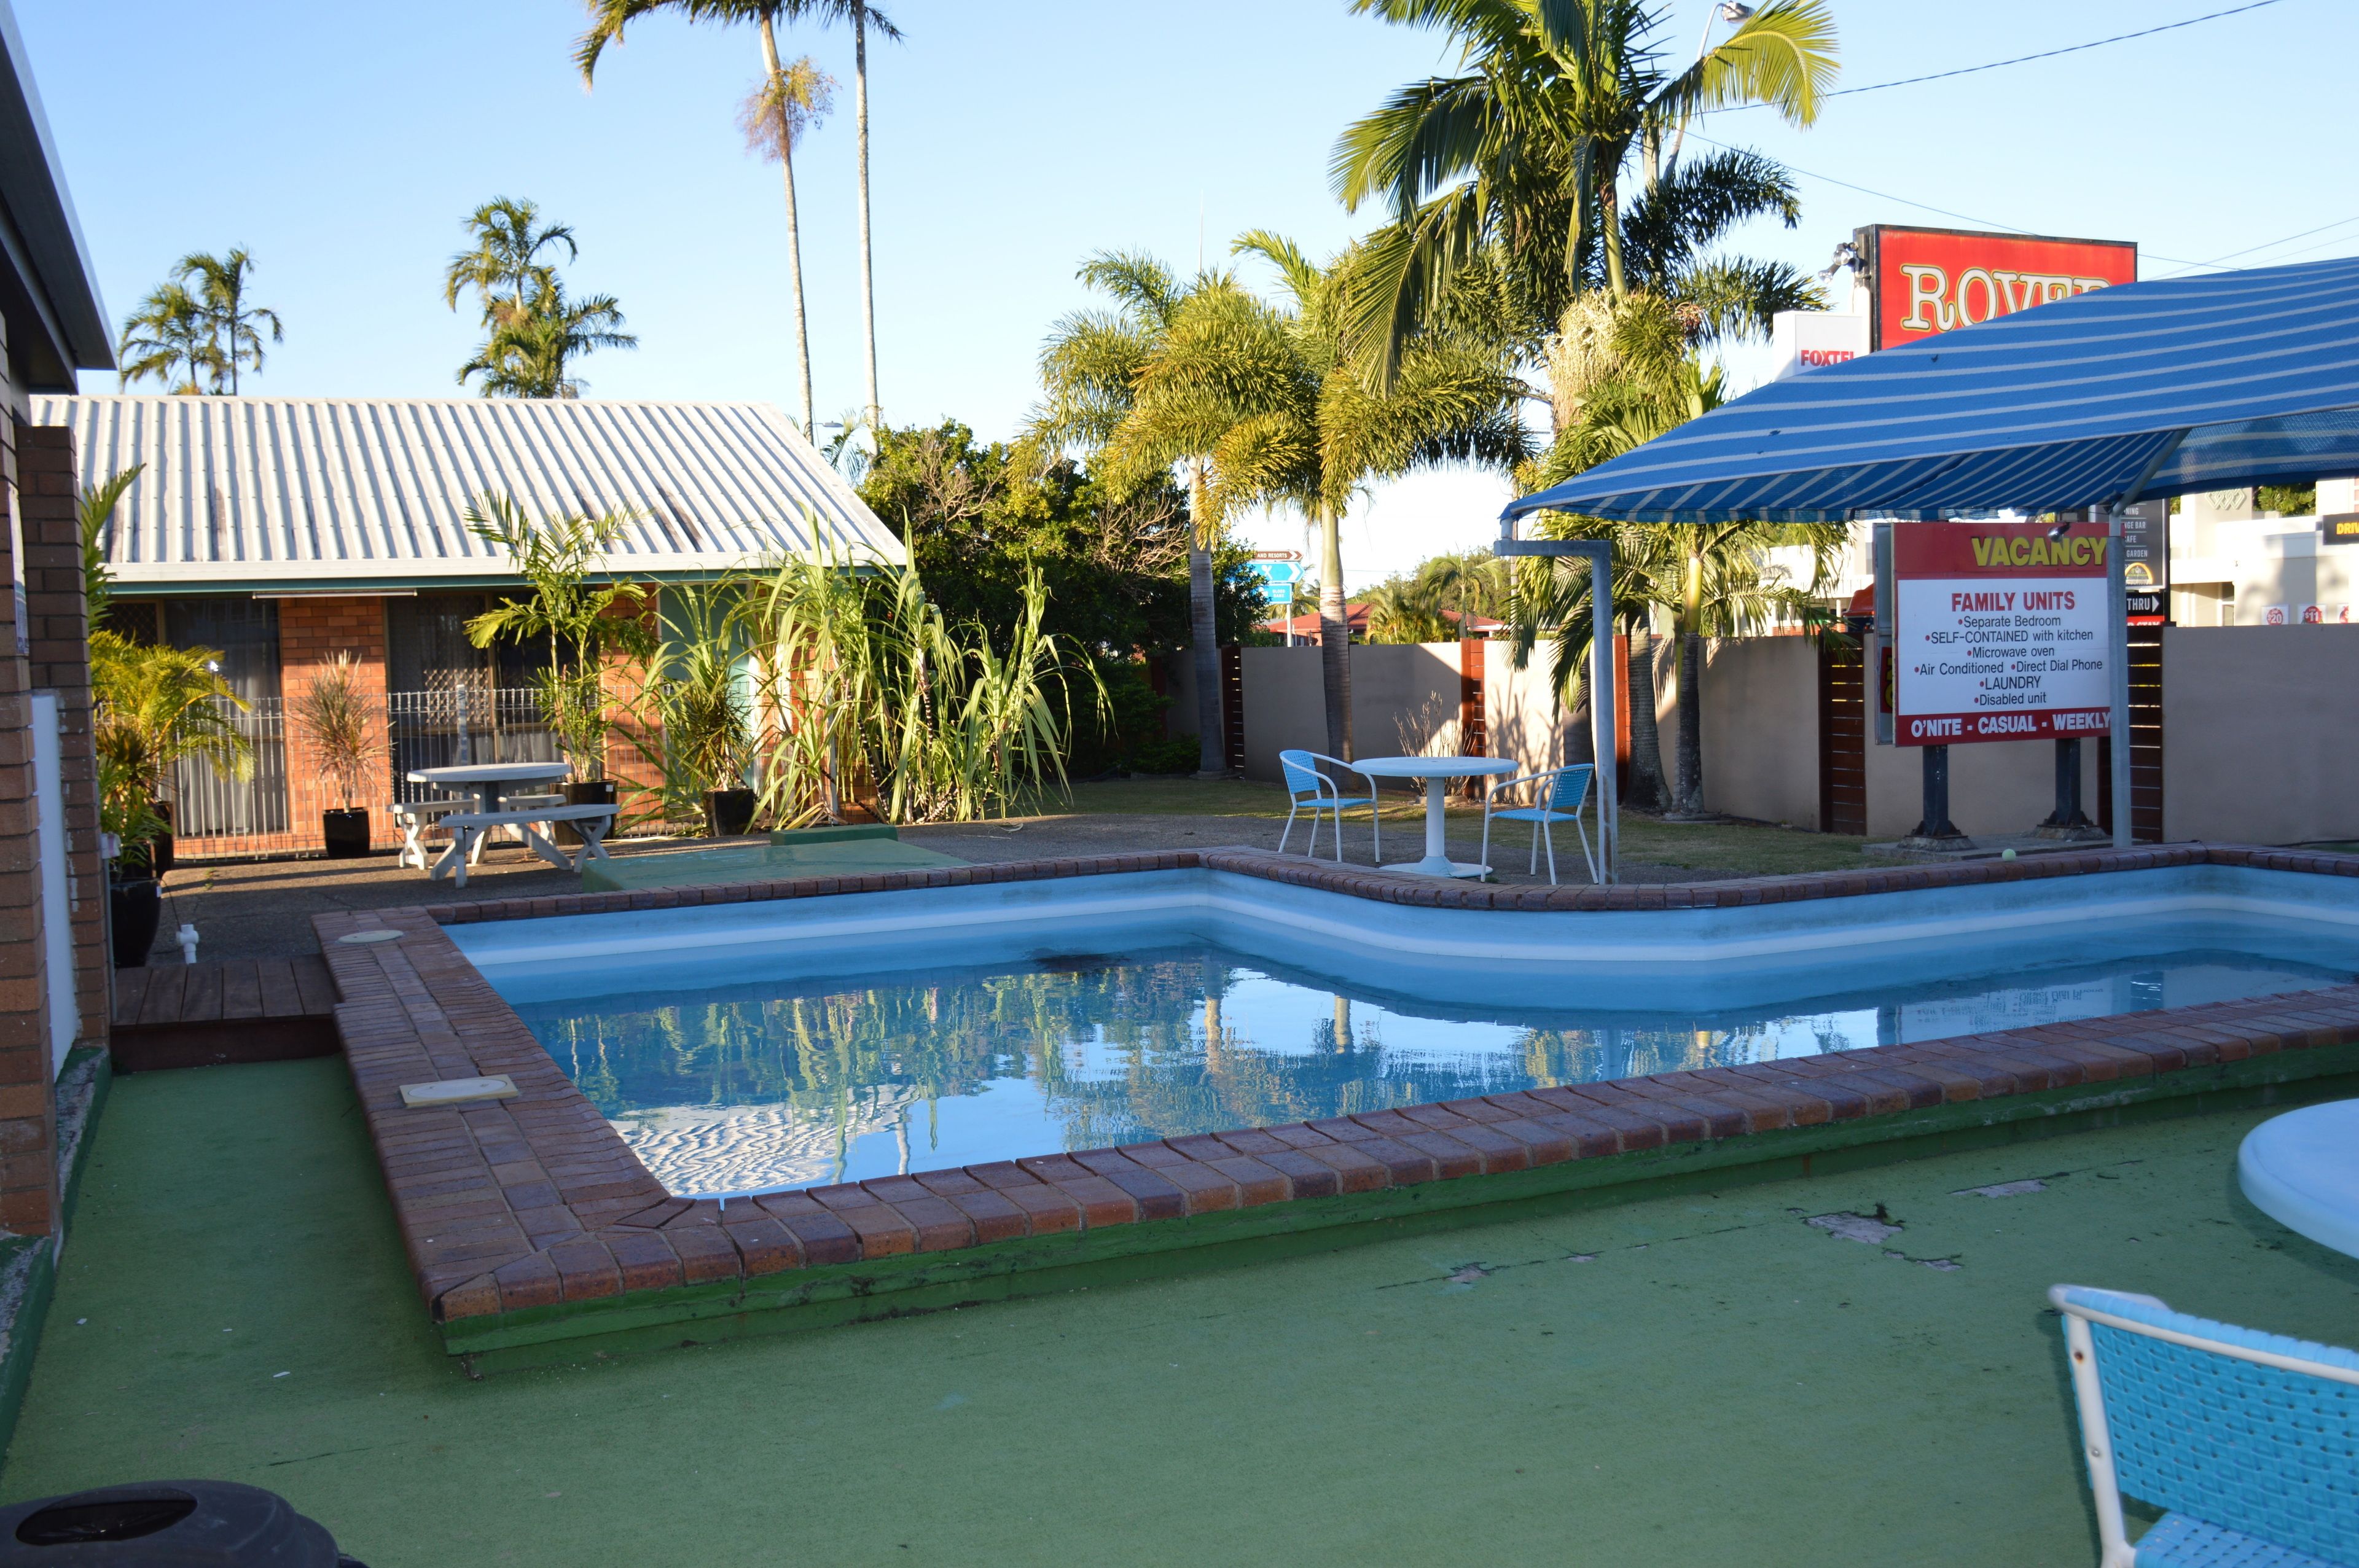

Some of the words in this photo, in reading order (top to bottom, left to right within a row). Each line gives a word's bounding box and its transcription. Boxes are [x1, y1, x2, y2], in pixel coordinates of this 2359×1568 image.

[1971, 536, 2107, 566] VACANCY
[1951, 592, 2016, 612] FAMILY
[2023, 591, 2075, 610] UNITS
[2127, 598, 2150, 610] THRU
[1963, 615, 2011, 630] Separate
[2014, 615, 2060, 626] Bedroom
[2267, 614, 2282, 623] $20
[2304, 611, 2318, 622] $11
[1931, 630, 2028, 644] SELF-CONTAINED
[2033, 630, 2054, 641] with
[2058, 629, 2093, 641] kitchen
[1973, 647, 2027, 658] Microwave
[2031, 647, 2054, 657] oven
[1920, 663, 1935, 675] Air
[1939, 661, 2003, 675] Conditioned
[2016, 660, 2046, 673] Direct
[2050, 659, 2068, 671] Dial
[2071, 658, 2103, 670] Phone
[1985, 676, 2041, 690] LAUNDRY
[1979, 692, 2024, 705] Disabled
[2027, 692, 2046, 703] unit
[1911, 718, 1962, 737] O'NITE
[1978, 715, 2036, 734] CASUAL
[2052, 711, 2111, 731] WEEKLY
